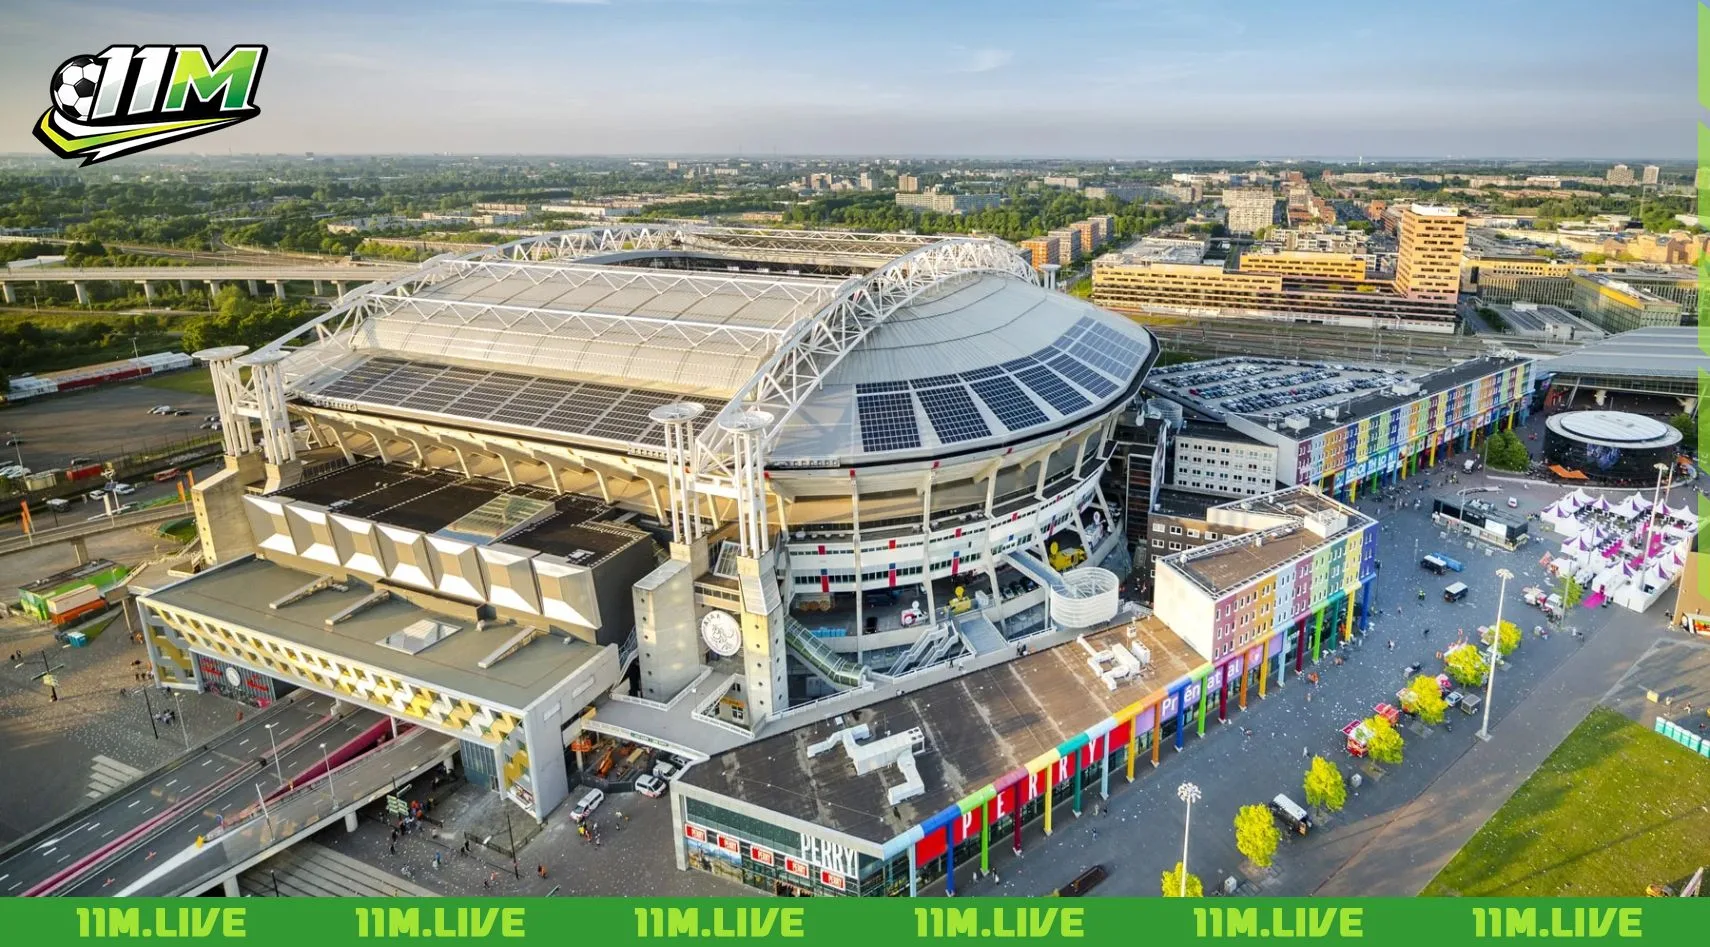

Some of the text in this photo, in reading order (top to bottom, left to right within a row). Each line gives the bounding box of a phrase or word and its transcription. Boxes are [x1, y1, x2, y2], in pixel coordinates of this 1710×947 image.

[1162, 657, 1239, 716] Prénatal
[962, 738, 1096, 839] PERRY
[801, 832, 854, 876] PERRY
